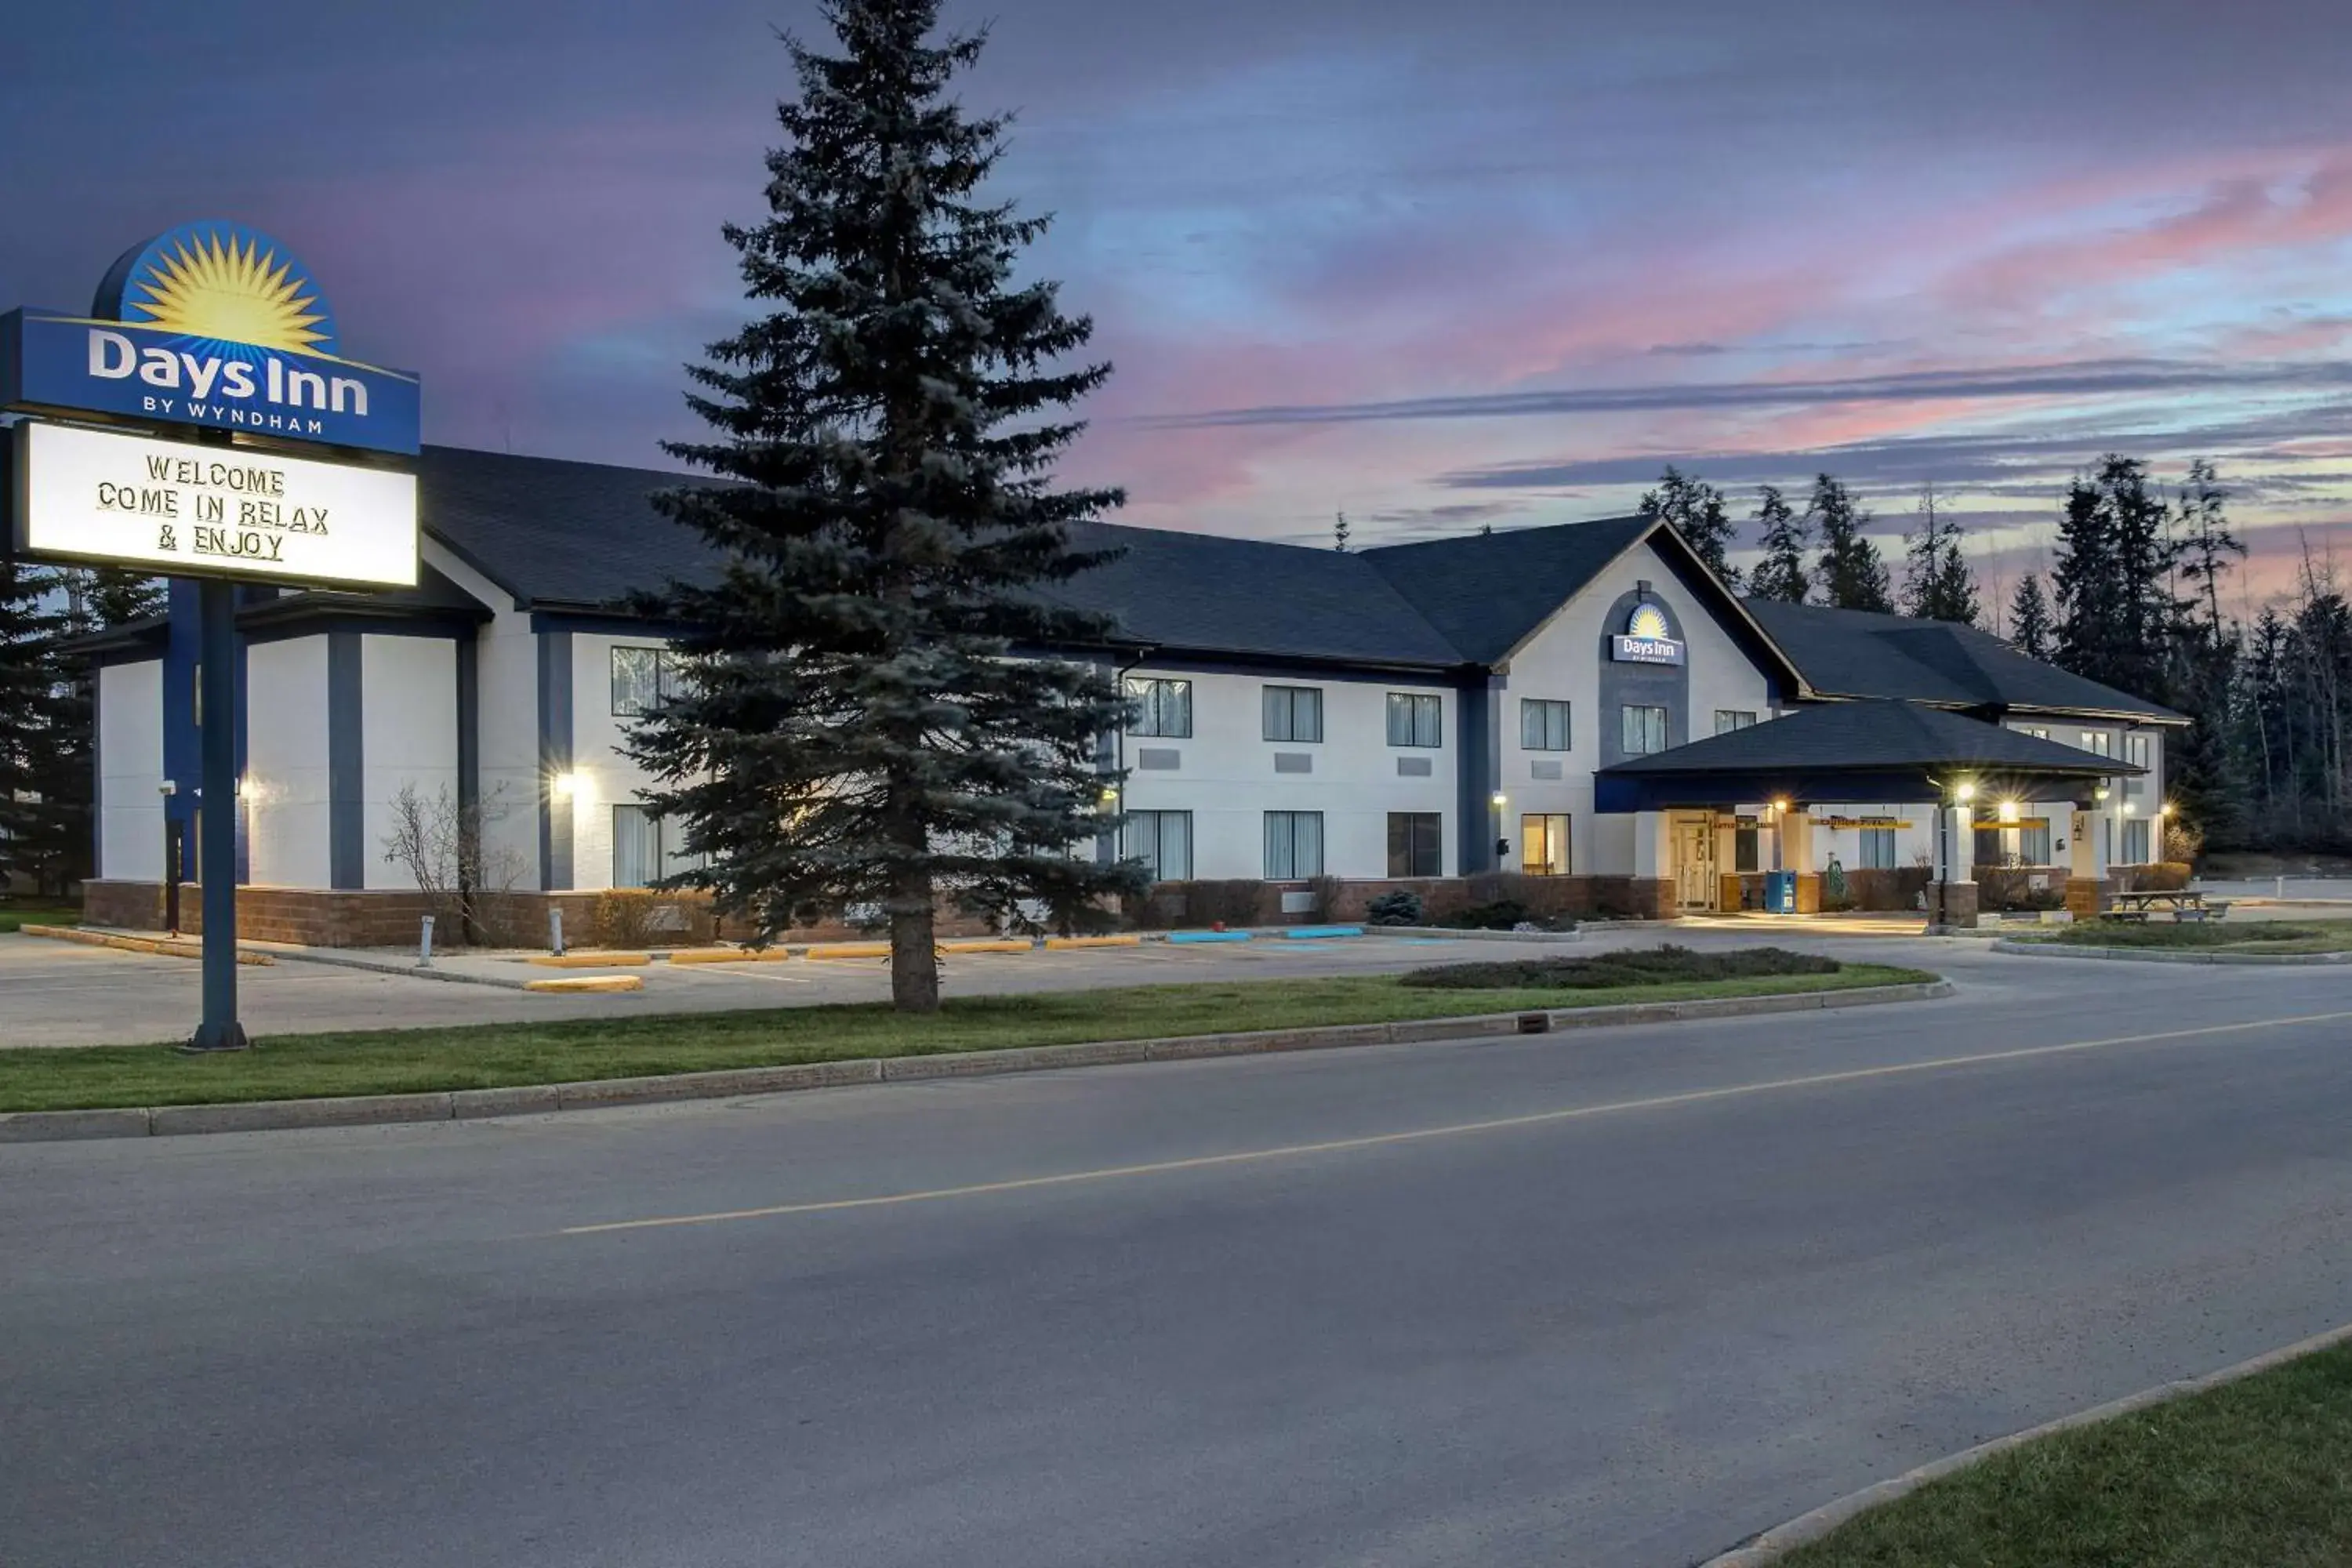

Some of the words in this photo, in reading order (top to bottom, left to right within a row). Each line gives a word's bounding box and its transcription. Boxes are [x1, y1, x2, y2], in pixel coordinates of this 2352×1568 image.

[89, 328, 255, 398] Days
[267, 358, 368, 416] Inn
[143, 396, 174, 413] BY
[188, 402, 322, 434] WYNDHAM
[147, 455, 285, 495] WELCOME
[97, 481, 179, 518] COME
[196, 495, 224, 522] IN
[238, 501, 329, 535] RELAX
[158, 524, 177, 550] &
[194, 525, 284, 561] ENJOY
[1624, 639, 1653, 655] Days
[1654, 641, 1675, 656] Inn
